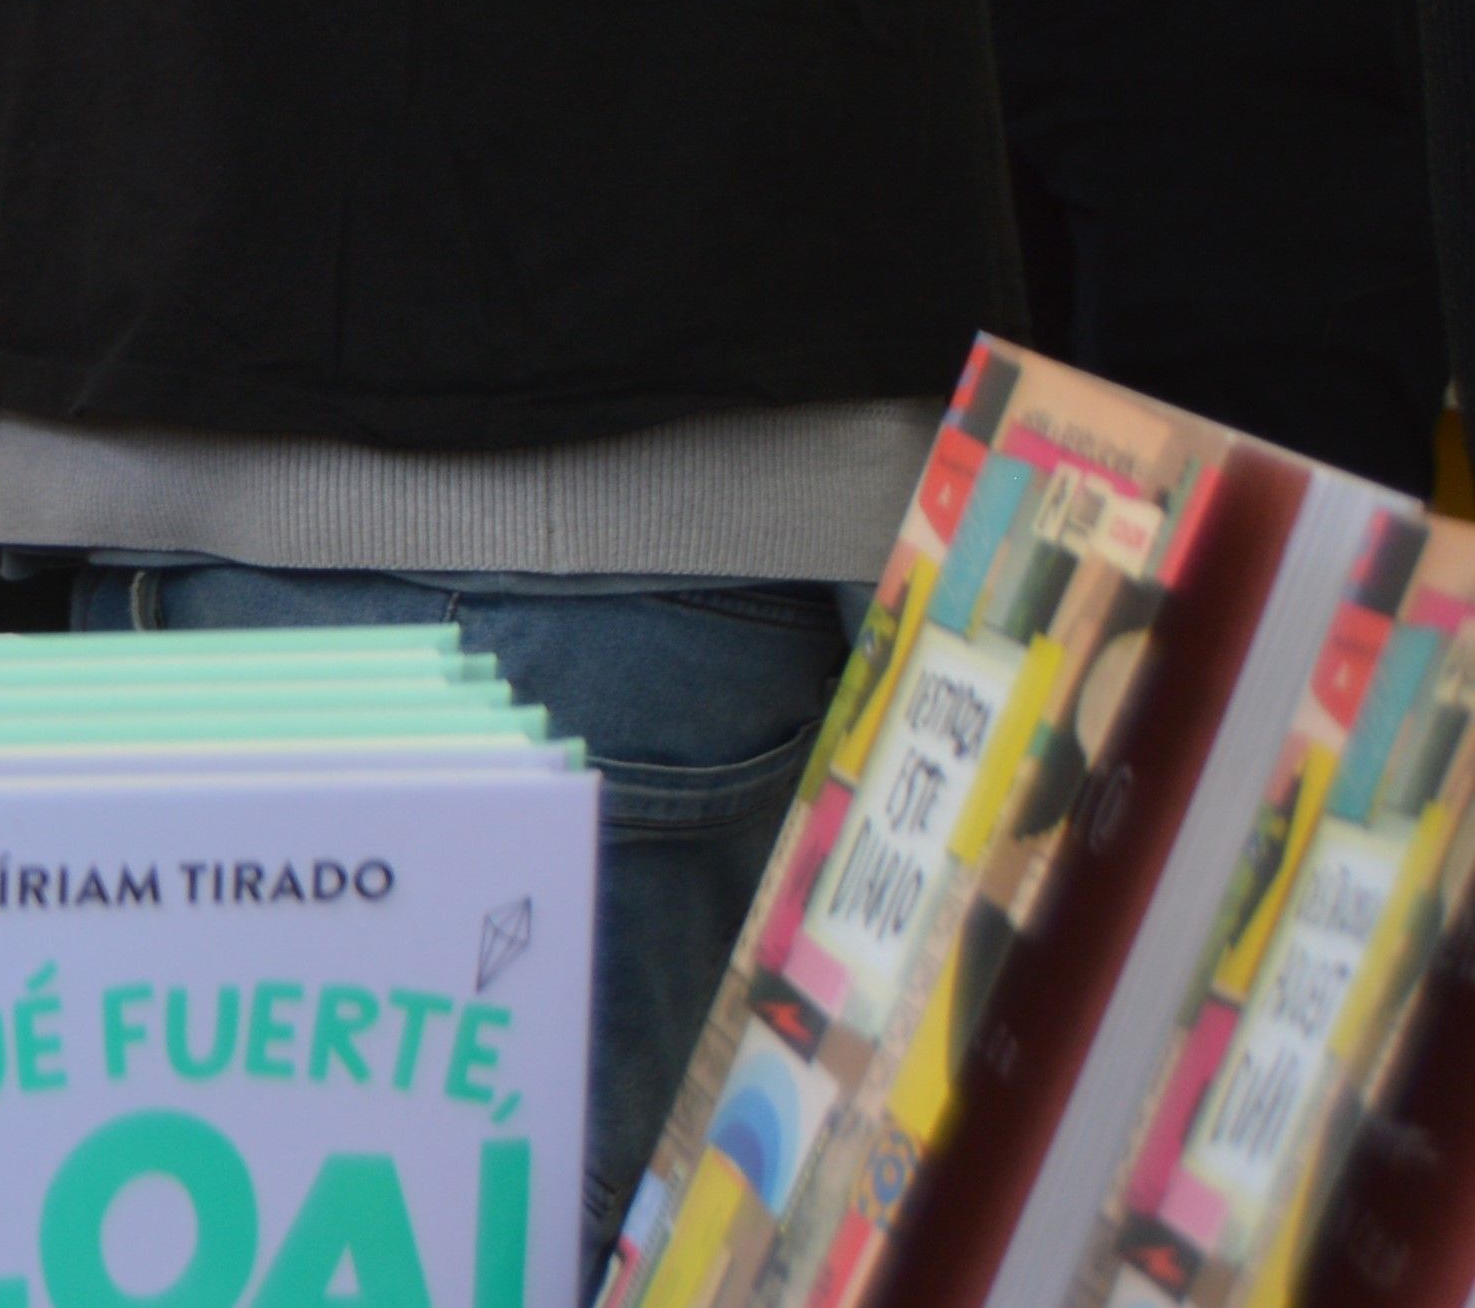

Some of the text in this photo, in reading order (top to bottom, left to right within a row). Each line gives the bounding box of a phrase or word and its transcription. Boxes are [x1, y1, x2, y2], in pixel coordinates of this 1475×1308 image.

[179, 857, 397, 905] TIRADO
[828, 817, 924, 942] DIARIO
[100, 979, 522, 1125] FUERTE,
